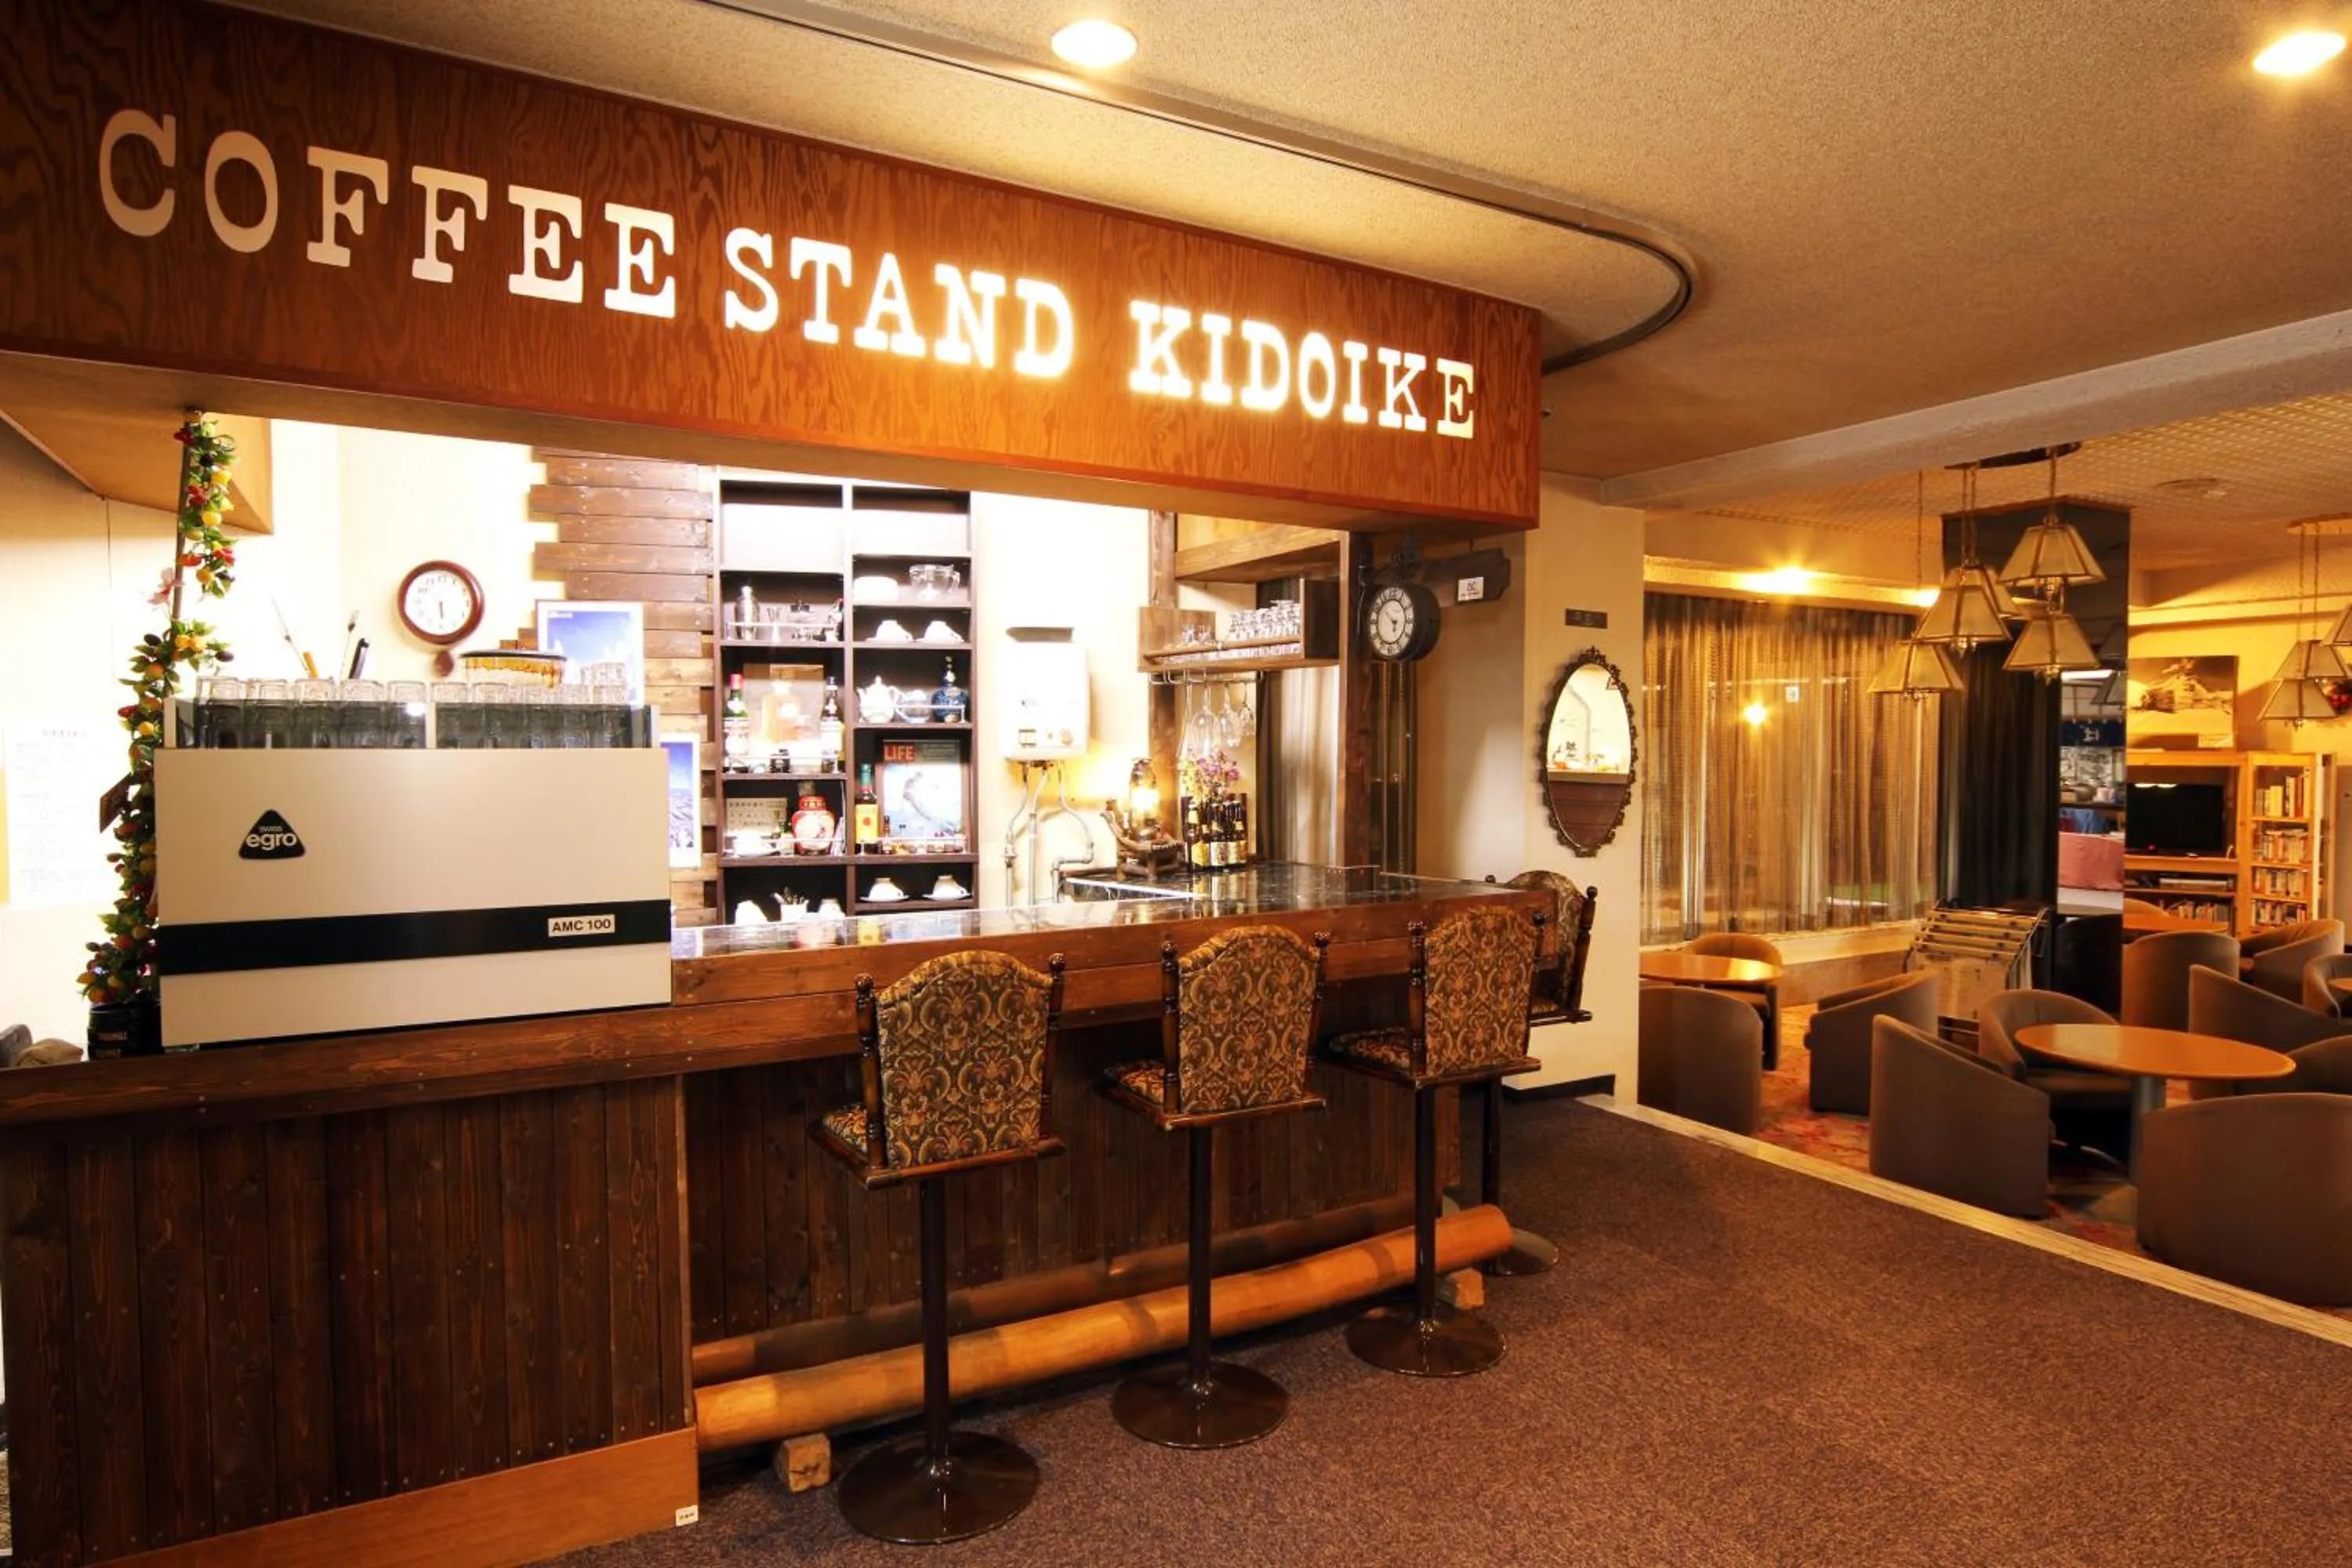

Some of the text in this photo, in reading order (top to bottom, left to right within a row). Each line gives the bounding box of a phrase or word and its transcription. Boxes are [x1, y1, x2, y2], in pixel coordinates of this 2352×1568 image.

[99, 108, 1474, 438] COFFEE STAND KIDOIKE
[884, 746, 914, 761] LIFE
[246, 833, 297, 851] egro
[552, 919, 611, 932] AMC 100
